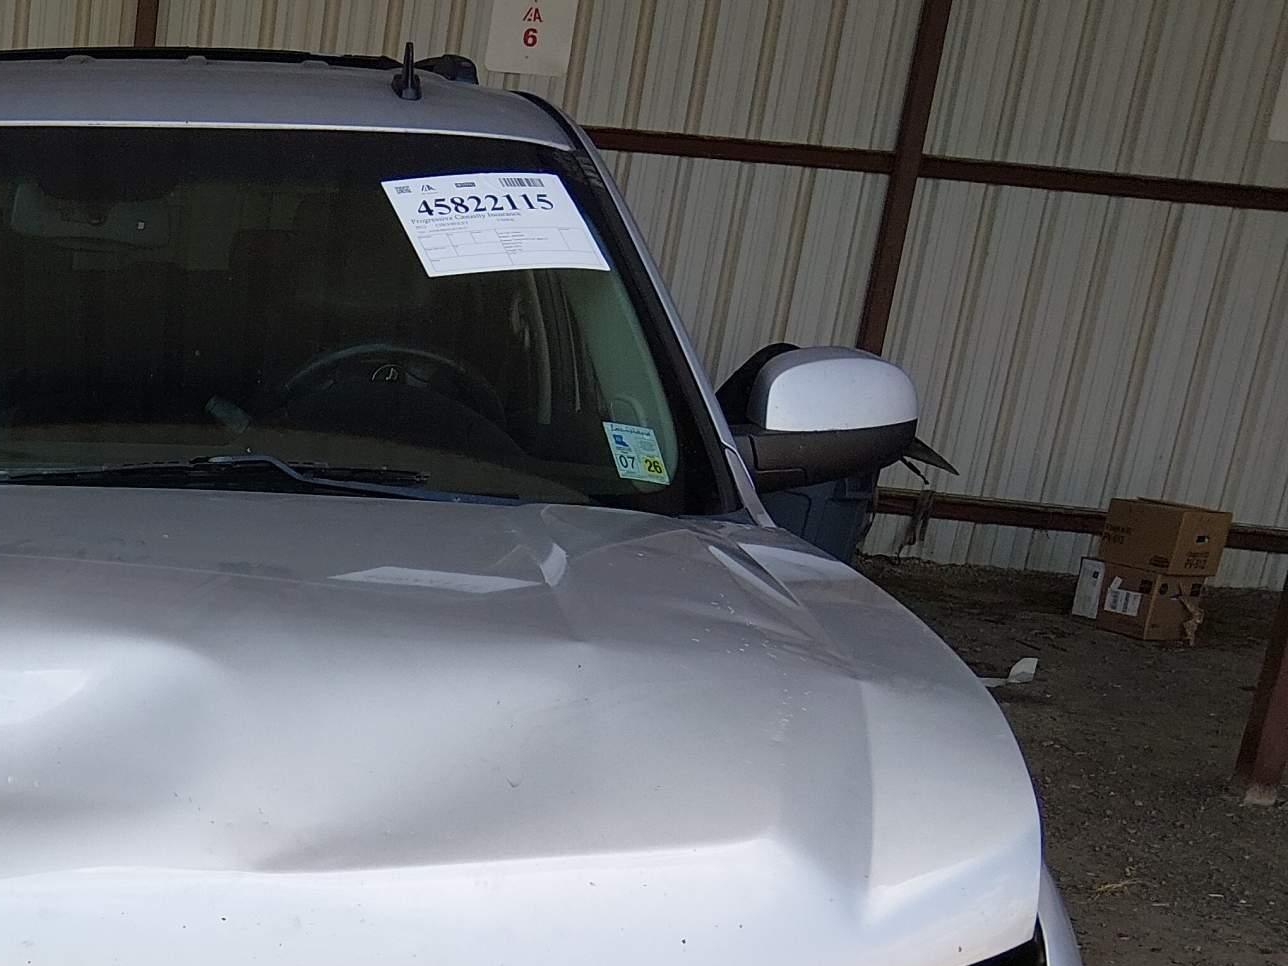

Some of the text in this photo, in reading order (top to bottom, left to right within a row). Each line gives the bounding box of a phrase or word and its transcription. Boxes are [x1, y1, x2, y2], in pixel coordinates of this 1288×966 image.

[523, 28, 538, 47] 6
[418, 193, 554, 216] 45822115
[619, 455, 663, 474] 07 26
